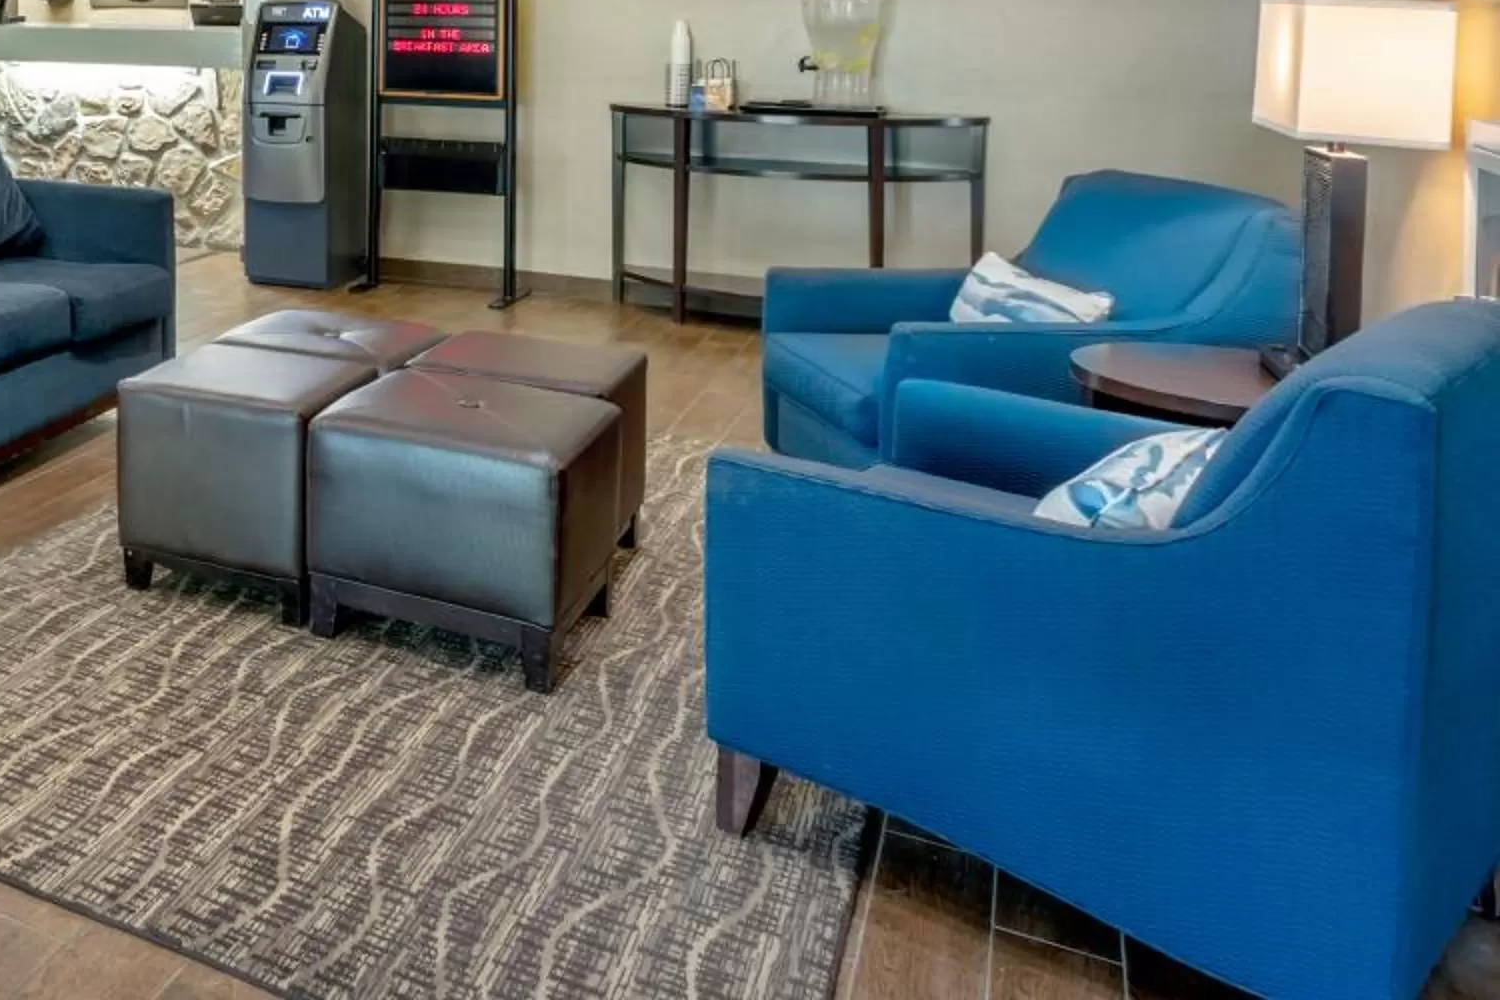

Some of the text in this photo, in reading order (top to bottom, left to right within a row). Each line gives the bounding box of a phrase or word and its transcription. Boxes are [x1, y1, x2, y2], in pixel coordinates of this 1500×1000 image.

[302, 6, 330, 20] ATM
[434, 4, 469, 15] HOURS
[440, 29, 461, 40] THE
[392, 41, 489, 53] BREAKFAST AREA
